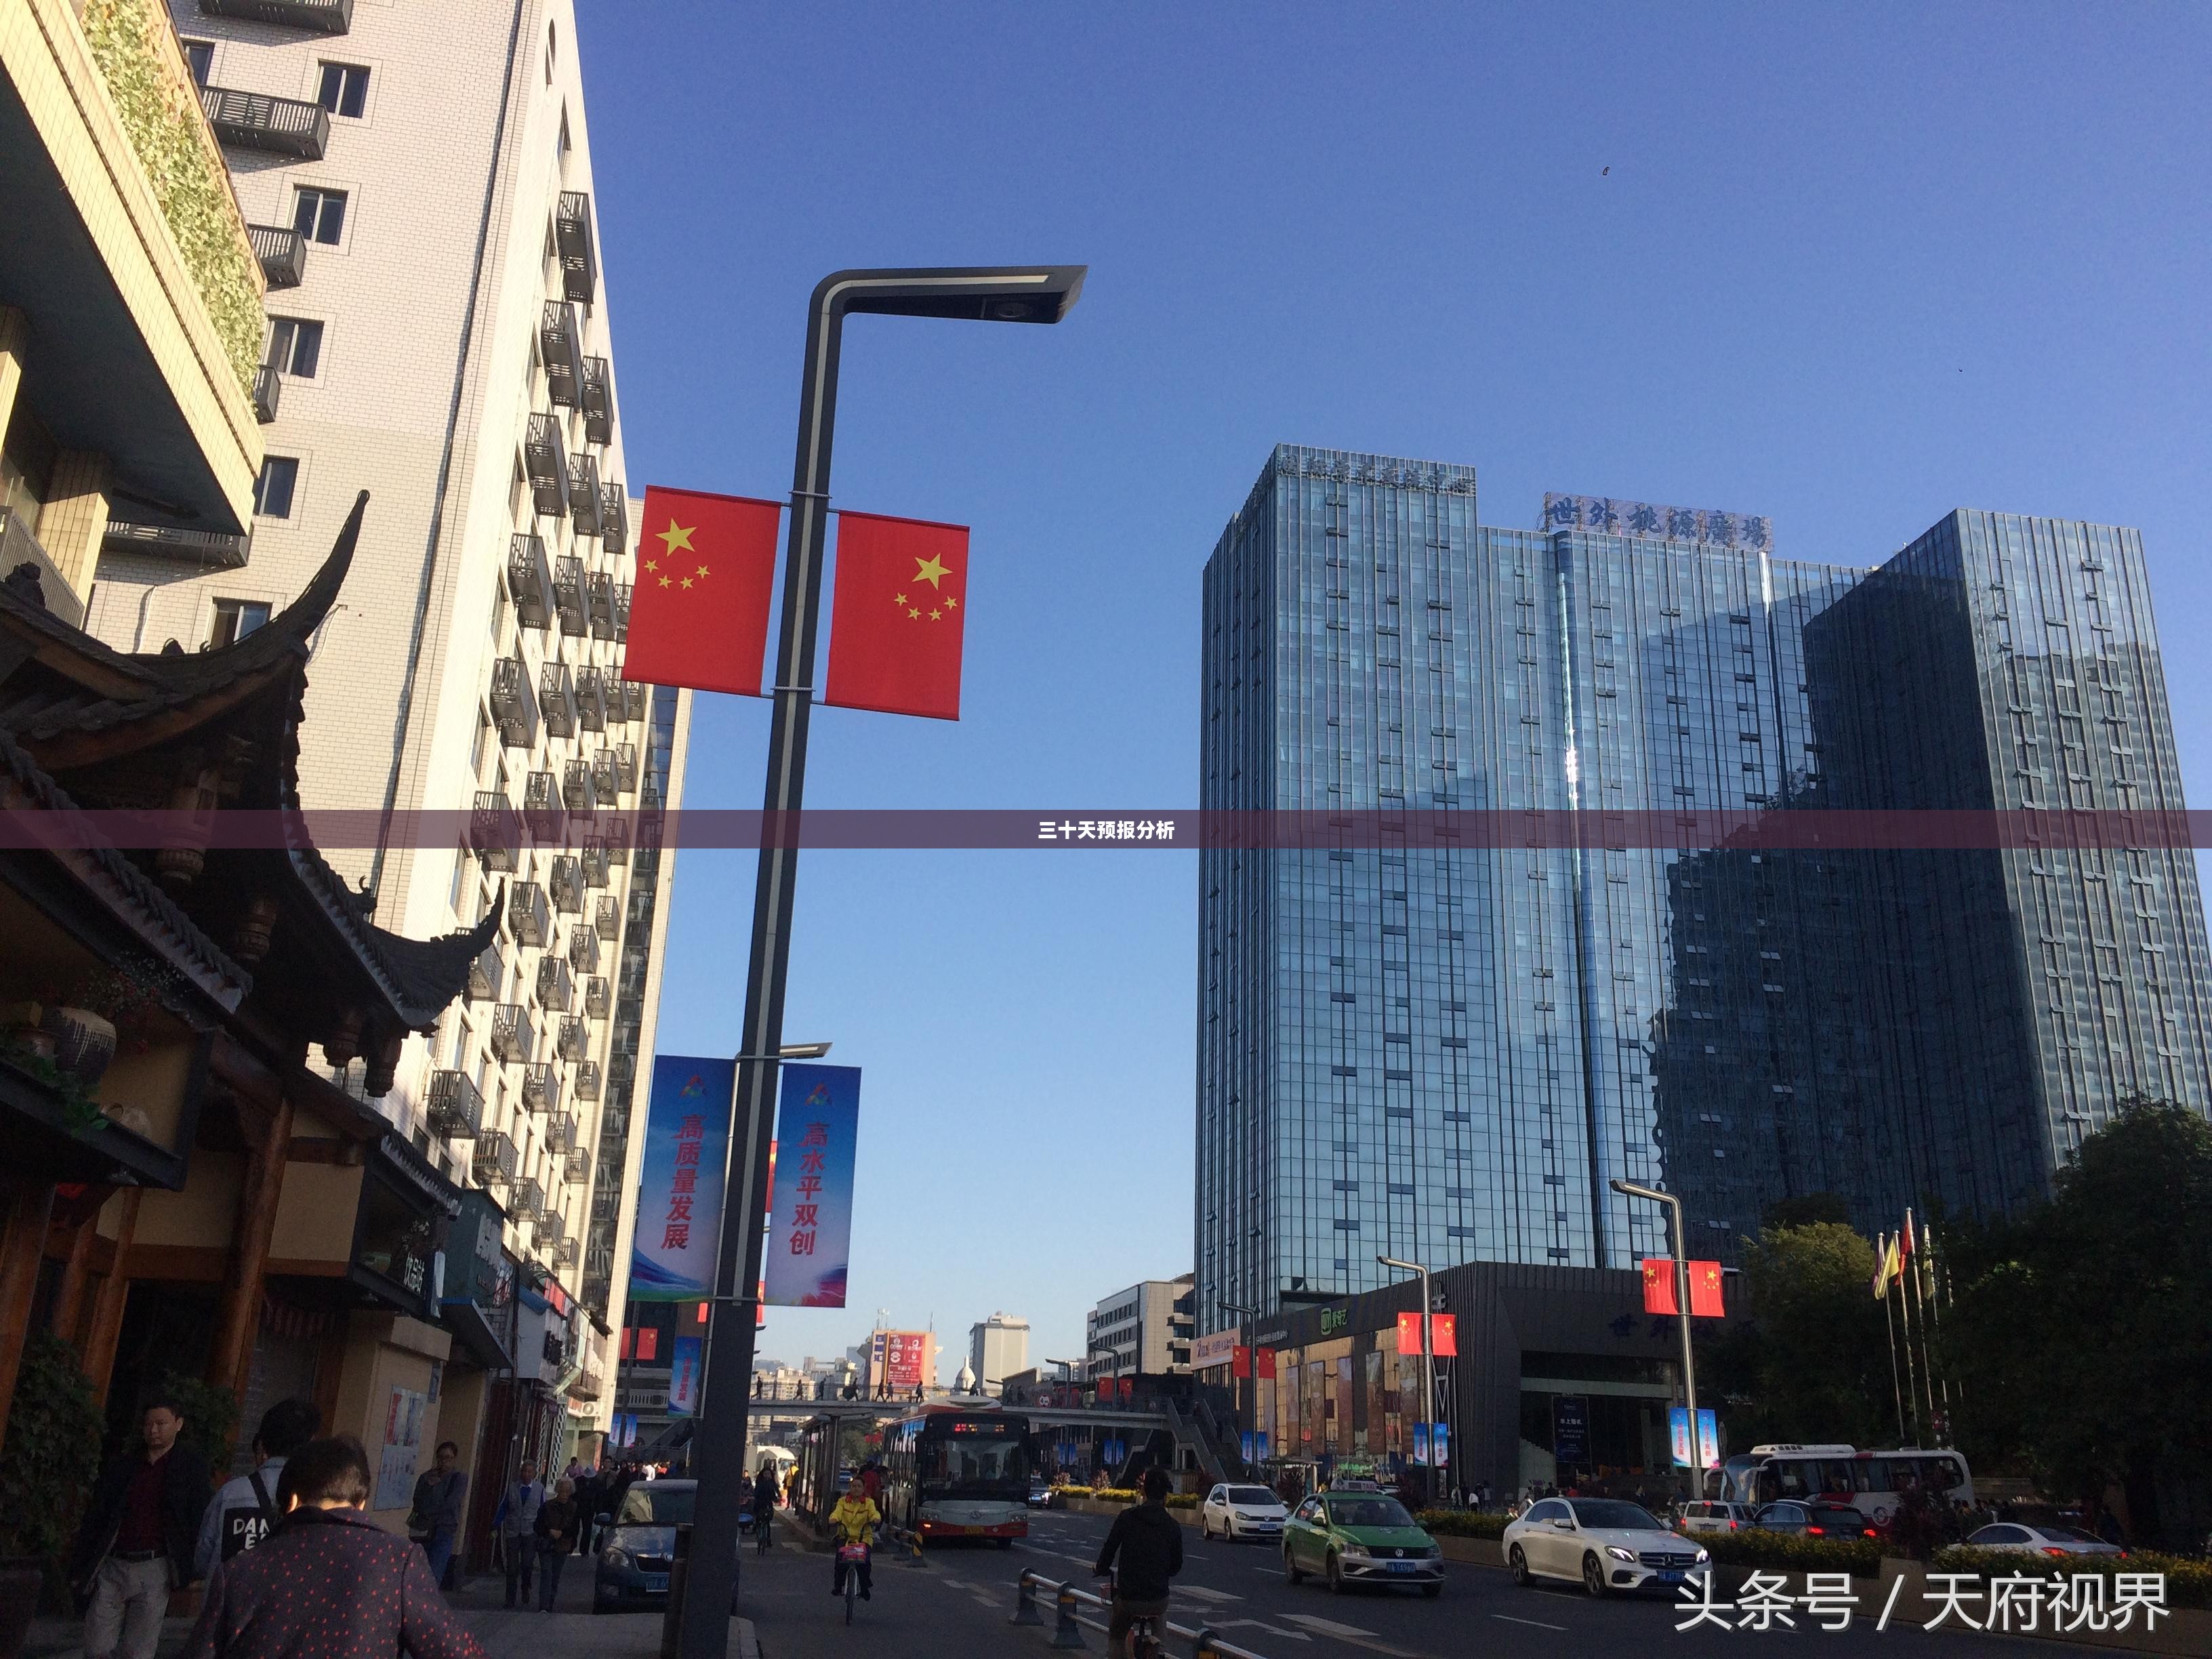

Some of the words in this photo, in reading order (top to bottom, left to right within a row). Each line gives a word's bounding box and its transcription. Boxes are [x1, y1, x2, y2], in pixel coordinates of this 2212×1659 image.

[661, 1113, 707, 1250] 高质量发展
[790, 1121, 830, 1256] 高水平双创
